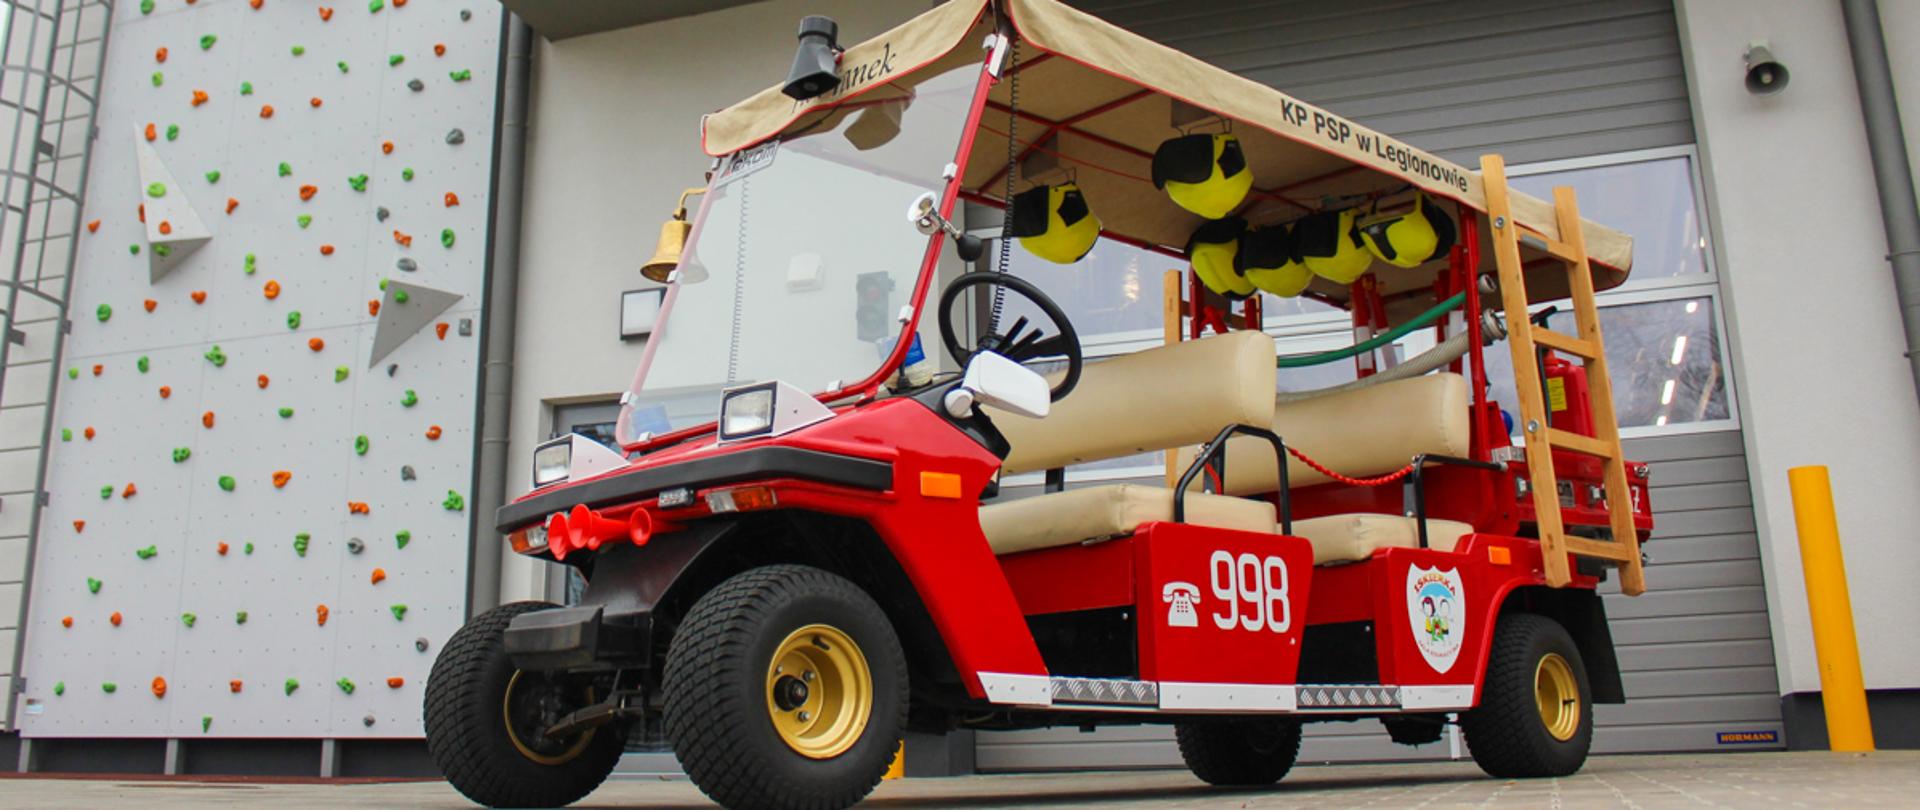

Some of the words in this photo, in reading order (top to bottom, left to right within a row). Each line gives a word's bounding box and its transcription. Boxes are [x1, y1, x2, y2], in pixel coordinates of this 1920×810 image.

[1280, 98, 1307, 127] KP
[1313, 112, 1350, 144] PSP
[1356, 133, 1371, 153] w
[1375, 135, 1467, 193] Legionowie
[1210, 550, 1291, 633] 998
